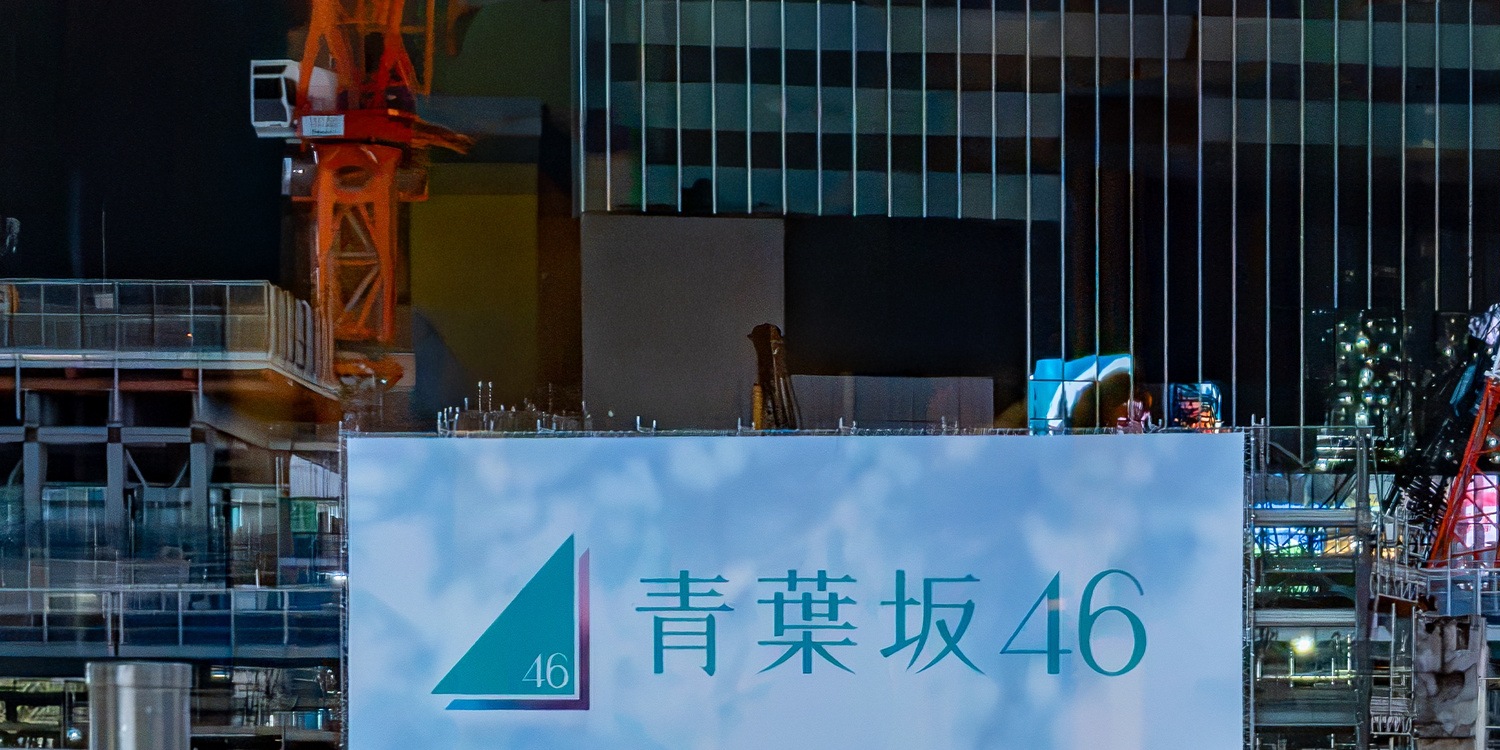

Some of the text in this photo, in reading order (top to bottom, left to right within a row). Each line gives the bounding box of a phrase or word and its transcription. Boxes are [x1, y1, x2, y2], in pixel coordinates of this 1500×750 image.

[635, 568, 1147, 676] 青葉坂46
[521, 652, 569, 689] 46
